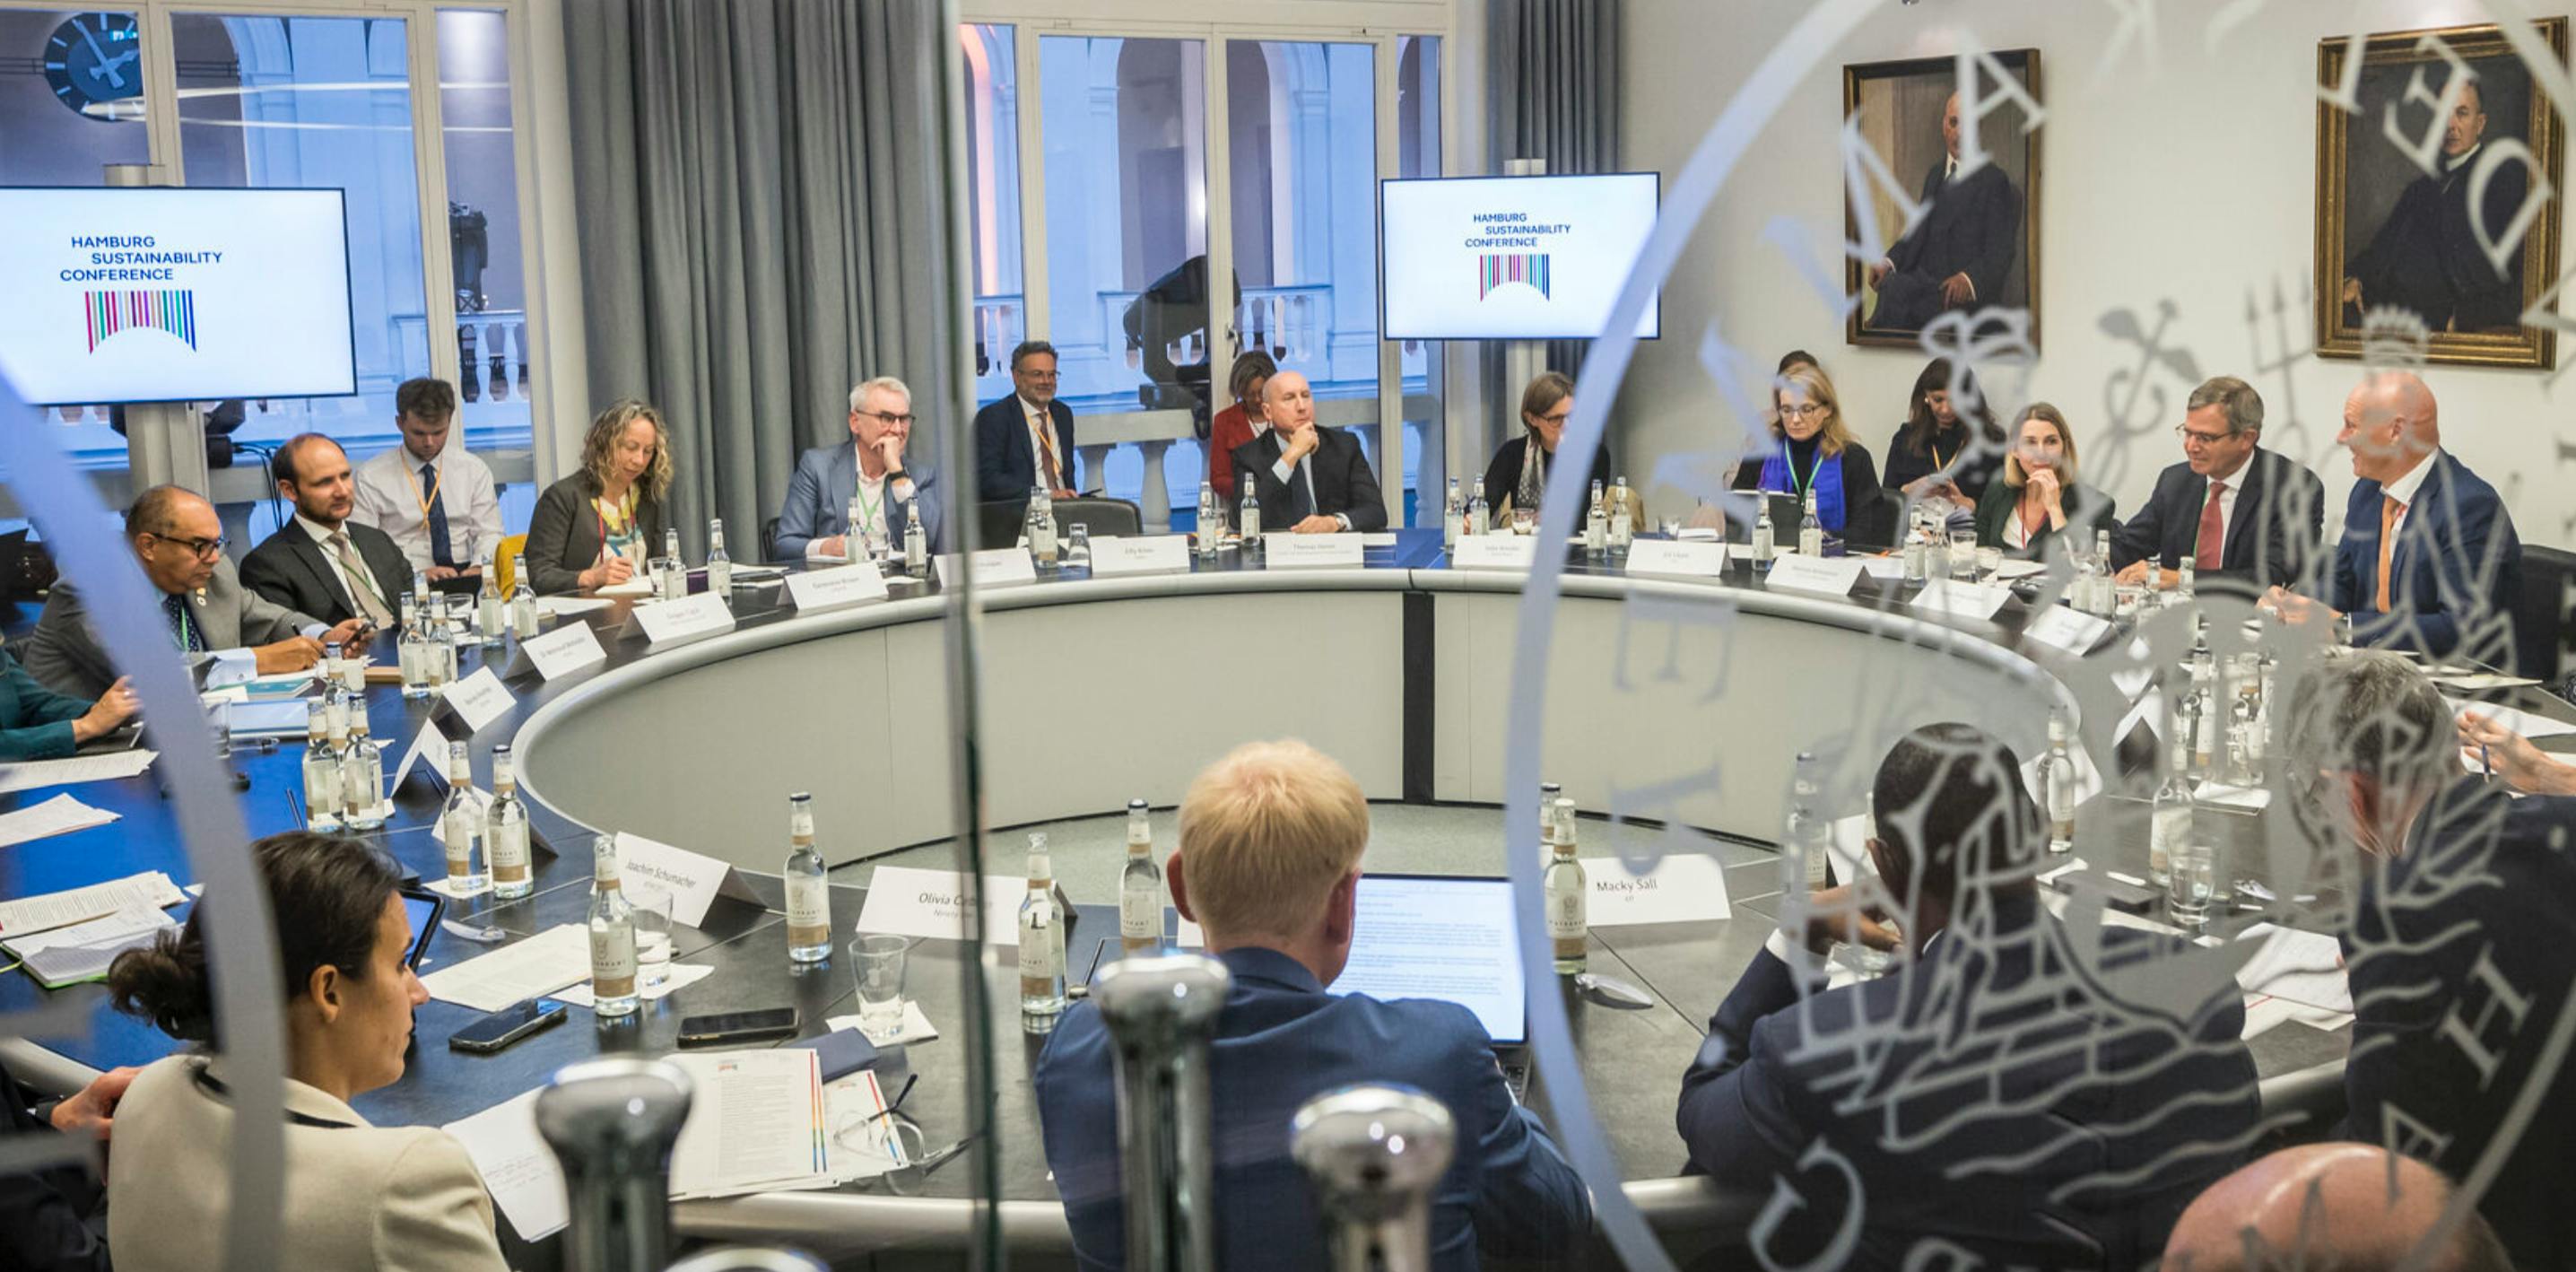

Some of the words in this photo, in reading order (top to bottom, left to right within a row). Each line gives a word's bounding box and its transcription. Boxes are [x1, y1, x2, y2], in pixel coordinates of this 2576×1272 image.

[1473, 213, 1527, 223] HAMBURG
[1484, 224, 1571, 236] SUSTAINABILITY
[71, 235, 156, 248] HAMBURG
[1464, 237, 1538, 248] CONFERENCE
[91, 251, 223, 265] SUSTAINABILITY
[59, 268, 174, 282] CONFERENCE
[1597, 879, 1634, 894] Macky
[1636, 878, 1658, 891] Sall
[919, 893, 951, 905] Olivia
